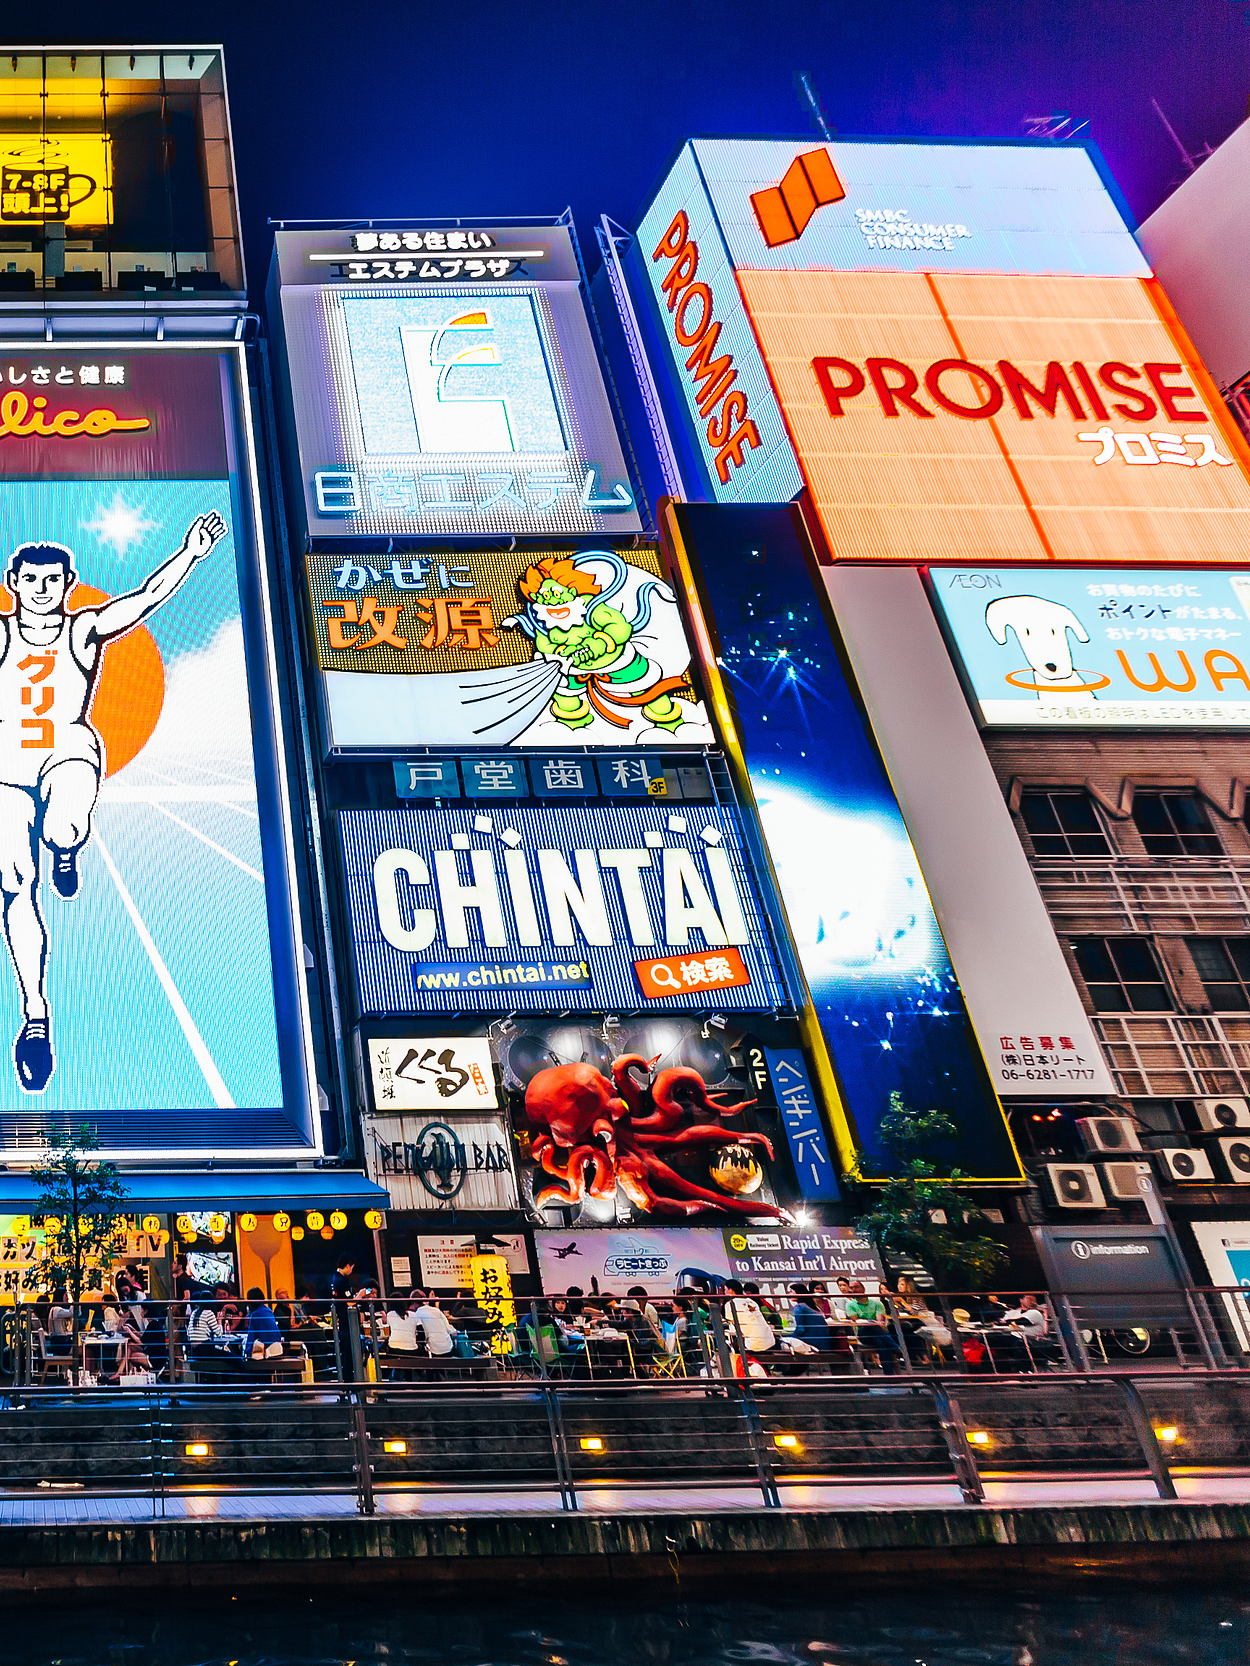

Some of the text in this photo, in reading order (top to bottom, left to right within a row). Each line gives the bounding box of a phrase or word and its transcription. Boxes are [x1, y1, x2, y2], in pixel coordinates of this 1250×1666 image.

[5, 173, 66, 191] 7-8F
[854, 209, 911, 223] SMBC
[353, 231, 494, 251] 夢ある住まい
[860, 223, 974, 239] CONSUMER
[865, 235, 956, 251] FINANCE
[347, 259, 511, 279] エステムプラザ
[652, 209, 761, 484] PROMISE
[811, 356, 1210, 423] PROMISE
[1077, 427, 1234, 467] プロミス
[314, 469, 632, 514] 日商エステム
[333, 557, 475, 592] かぜに
[1086, 583, 1202, 597] お買物のたびに
[322, 597, 501, 652] 改源
[1104, 627, 1242, 641] おトクな電子マネー
[17, 650, 58, 748] グリコ
[406, 759, 652, 791] 戸堂歯科
[650, 781, 665, 794] 3F
[372, 814, 750, 953] CHINTAI
[680, 956, 735, 987] 検索
[1000, 1036, 1076, 1050] 広告募集
[395, 1048, 470, 1098] くくる
[749, 1048, 767, 1090] 2F
[1001, 1068, 1095, 1081] 06-6281-1717
[775, 1060, 826, 1186] ペンギンバー
[380, 1140, 512, 1175] PENGUIN BAR
[781, 1234, 871, 1254] Rapid Express
[1090, 1243, 1150, 1255] information
[735, 1260, 749, 1271] to
[751, 1256, 797, 1271] Kansai
[829, 1256, 876, 1275] Airport
